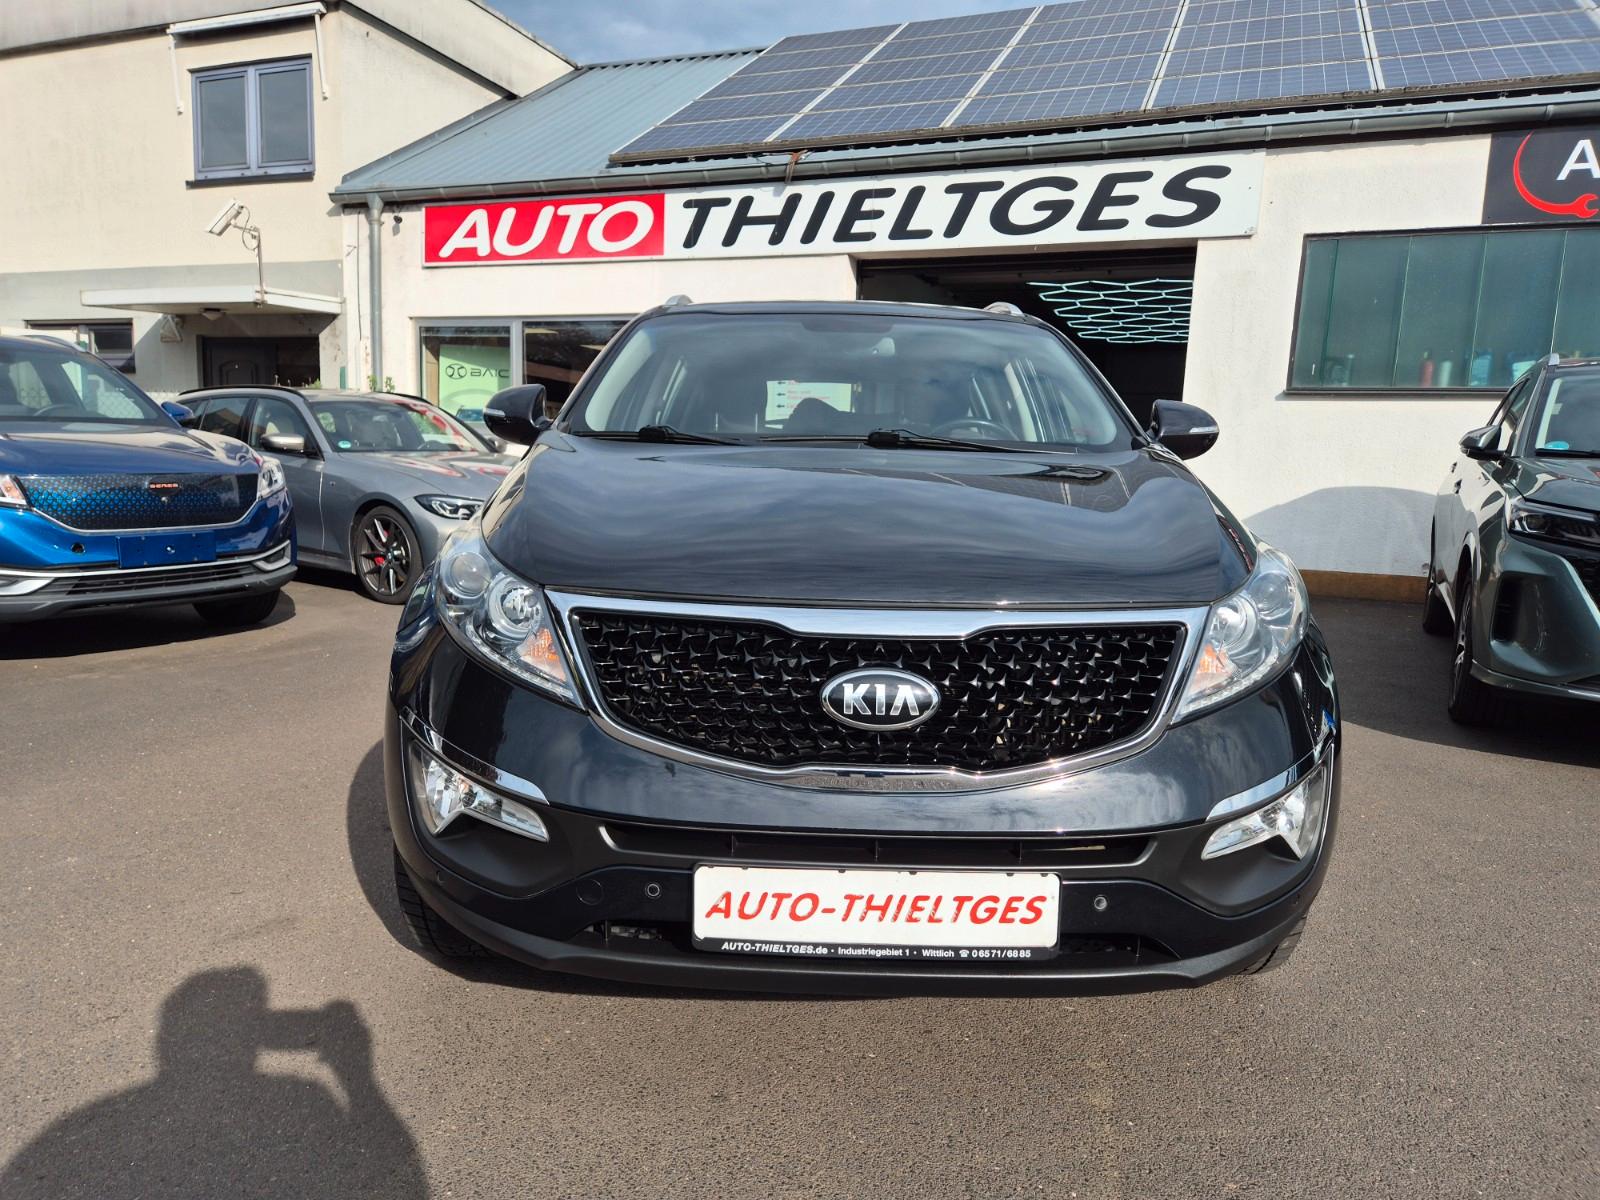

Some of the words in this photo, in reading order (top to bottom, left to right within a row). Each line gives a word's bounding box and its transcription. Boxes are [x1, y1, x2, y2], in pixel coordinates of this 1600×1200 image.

[1556, 139, 1600, 181] A
[438, 200, 655, 258] AUTO
[682, 164, 1232, 249] THIELTGES
[470, 367, 510, 378] BAIC
[842, 683, 920, 716] KIA
[705, 891, 1047, 924] AUTO-THIELTGES
[721, 942, 828, 955] AUTO-THIELTGES.de
[838, 946, 903, 958] Industriegebiet
[905, 948, 910, 957] 1
[922, 948, 955, 958] Wittlich
